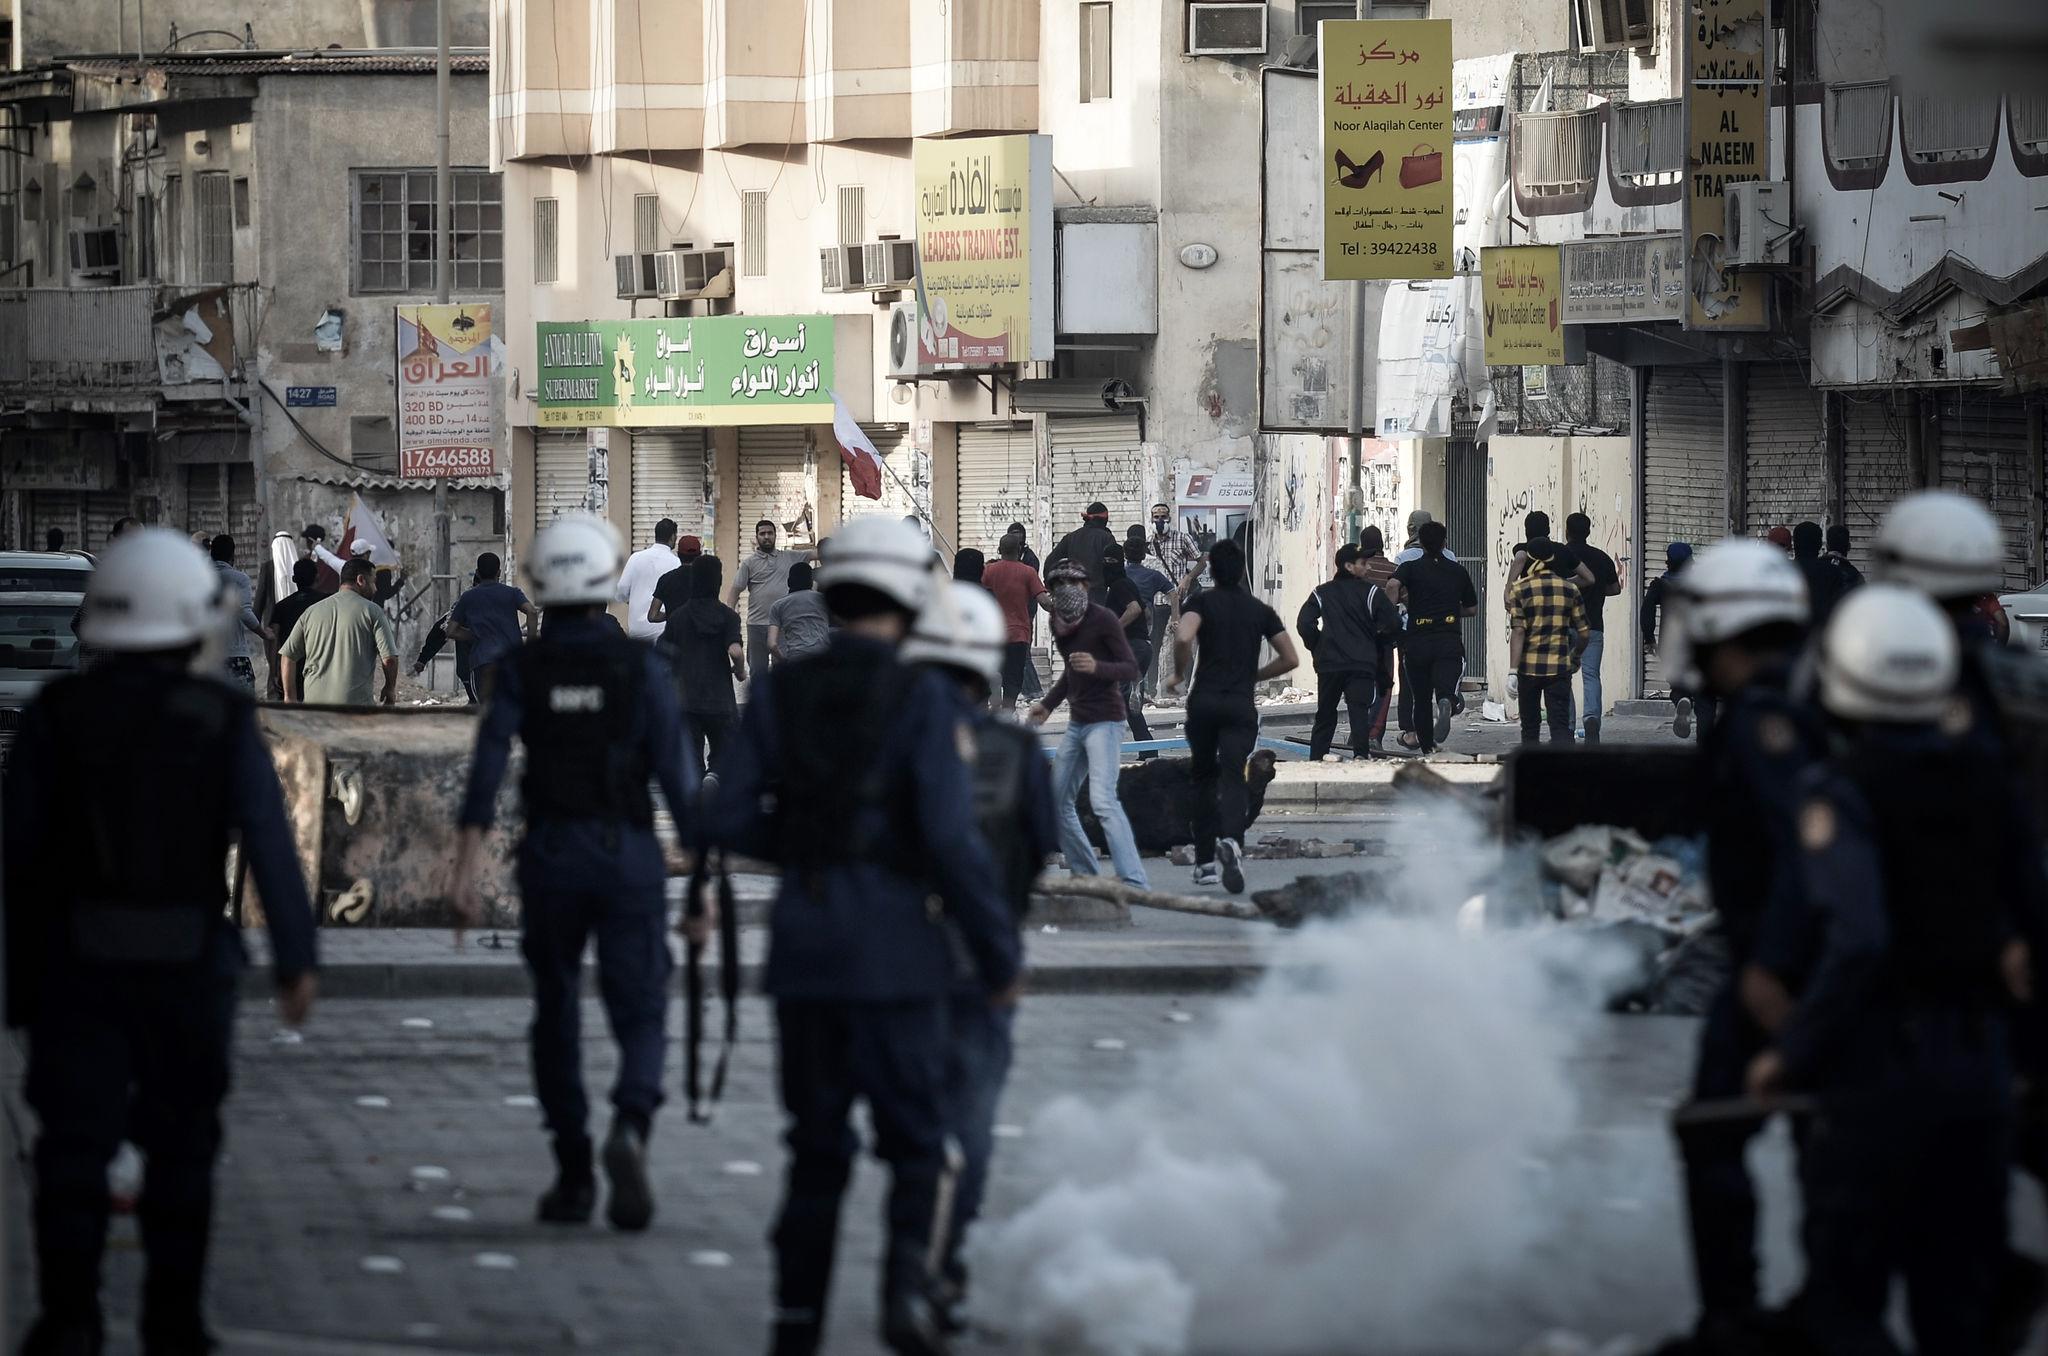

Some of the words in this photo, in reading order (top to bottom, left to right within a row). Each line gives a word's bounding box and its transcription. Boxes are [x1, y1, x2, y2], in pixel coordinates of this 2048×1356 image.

[1357, 40, 1419, 66] مركز
[1334, 81, 1407, 110] العقيلة
[1413, 86, 1444, 110] نور
[1334, 121, 1360, 131] Noor
[1363, 120, 1405, 132] Alaqilah
[1408, 120, 1444, 131] Center
[1720, 110, 1739, 133] AL
[1701, 142, 1755, 165] NAEEM
[950, 156, 991, 216] القادة
[1406, 221, 1424, 229] بنات
[922, 231, 960, 262] LEADERS
[962, 229, 1002, 261] TRADING
[1004, 228, 1023, 259] EST.
[1340, 242, 1359, 255] Tel
[1370, 242, 1437, 255] 39422438
[1720, 270, 1742, 293] ST.
[1497, 303, 1509, 325] Noor
[1530, 302, 1546, 325] Center
[544, 333, 572, 367] ANWAR
[572, 332, 604, 367] AL-LIWA
[656, 322, 693, 360] أسواق
[743, 322, 806, 359] أسواق
[404, 355, 488, 385] العراق
[731, 364, 779, 399] اللواء
[778, 358, 820, 398] أنوار
[288, 388, 312, 399] 1427
[545, 378, 600, 401] SUPERMARKET
[404, 401, 426, 412] 320
[428, 401, 444, 411] BD
[466, 414, 477, 422] 14
[404, 415, 426, 425] 400
[429, 414, 444, 425] BD
[405, 448, 491, 468] 17646588
[406, 467, 445, 477] 33176579
[452, 466, 491, 476] 33893373
